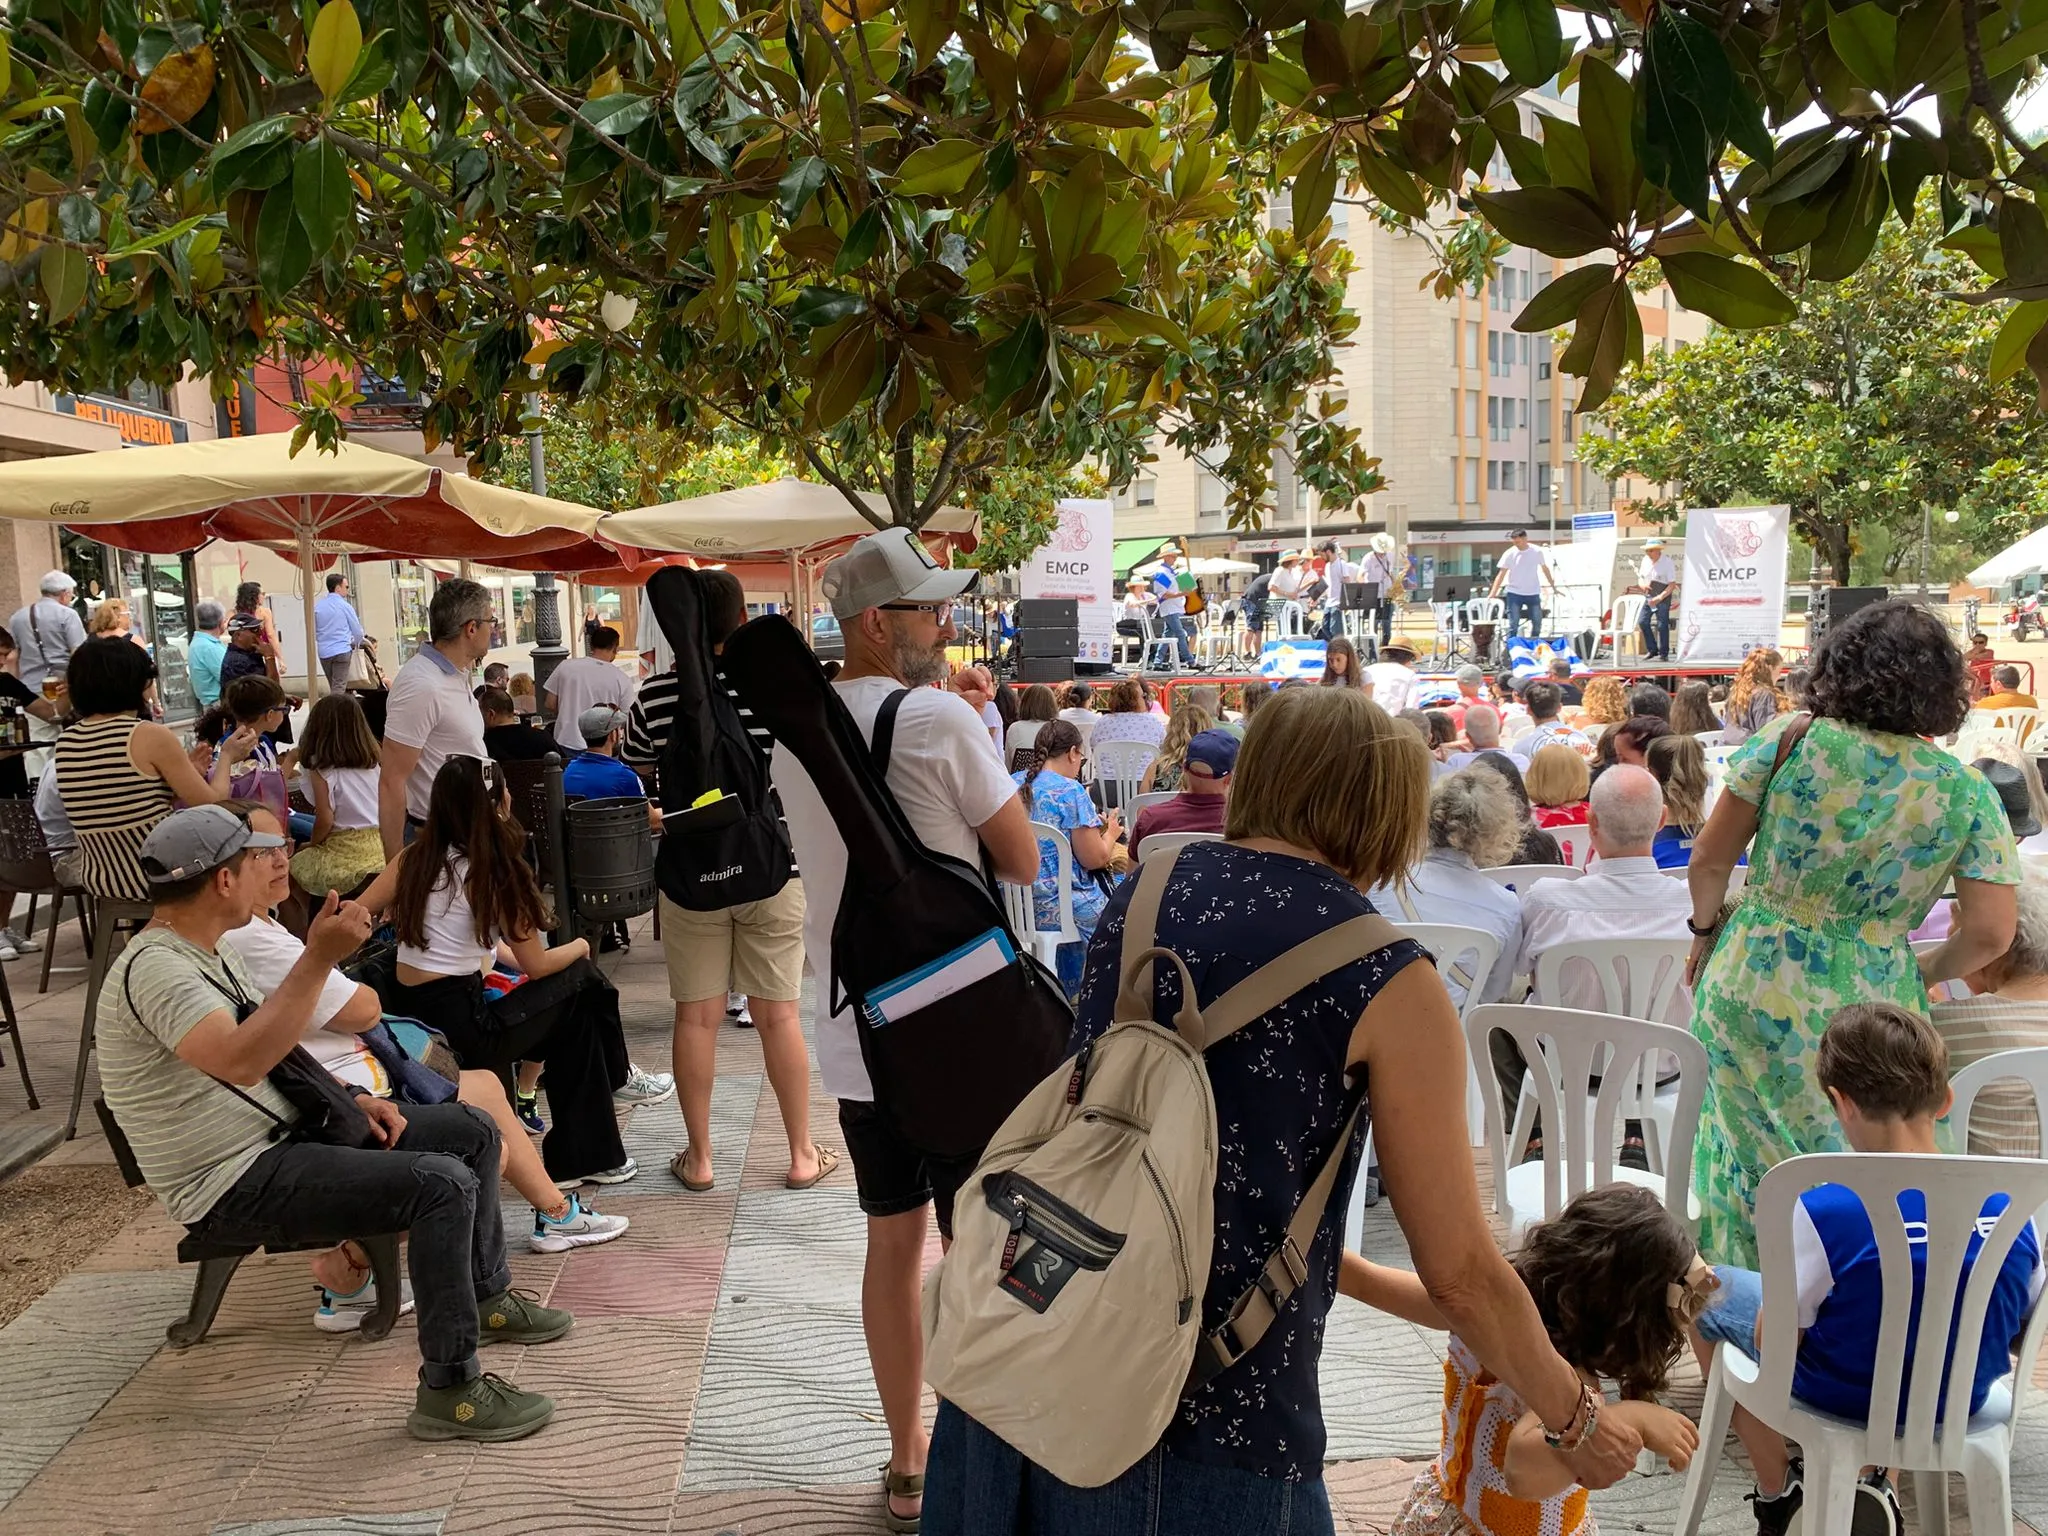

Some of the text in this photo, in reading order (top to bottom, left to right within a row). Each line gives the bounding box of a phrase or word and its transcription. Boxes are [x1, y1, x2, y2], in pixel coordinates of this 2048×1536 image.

[1046, 561, 1089, 575] EMCP
[1708, 567, 1757, 581] EMCP
[700, 864, 743, 882] admira
